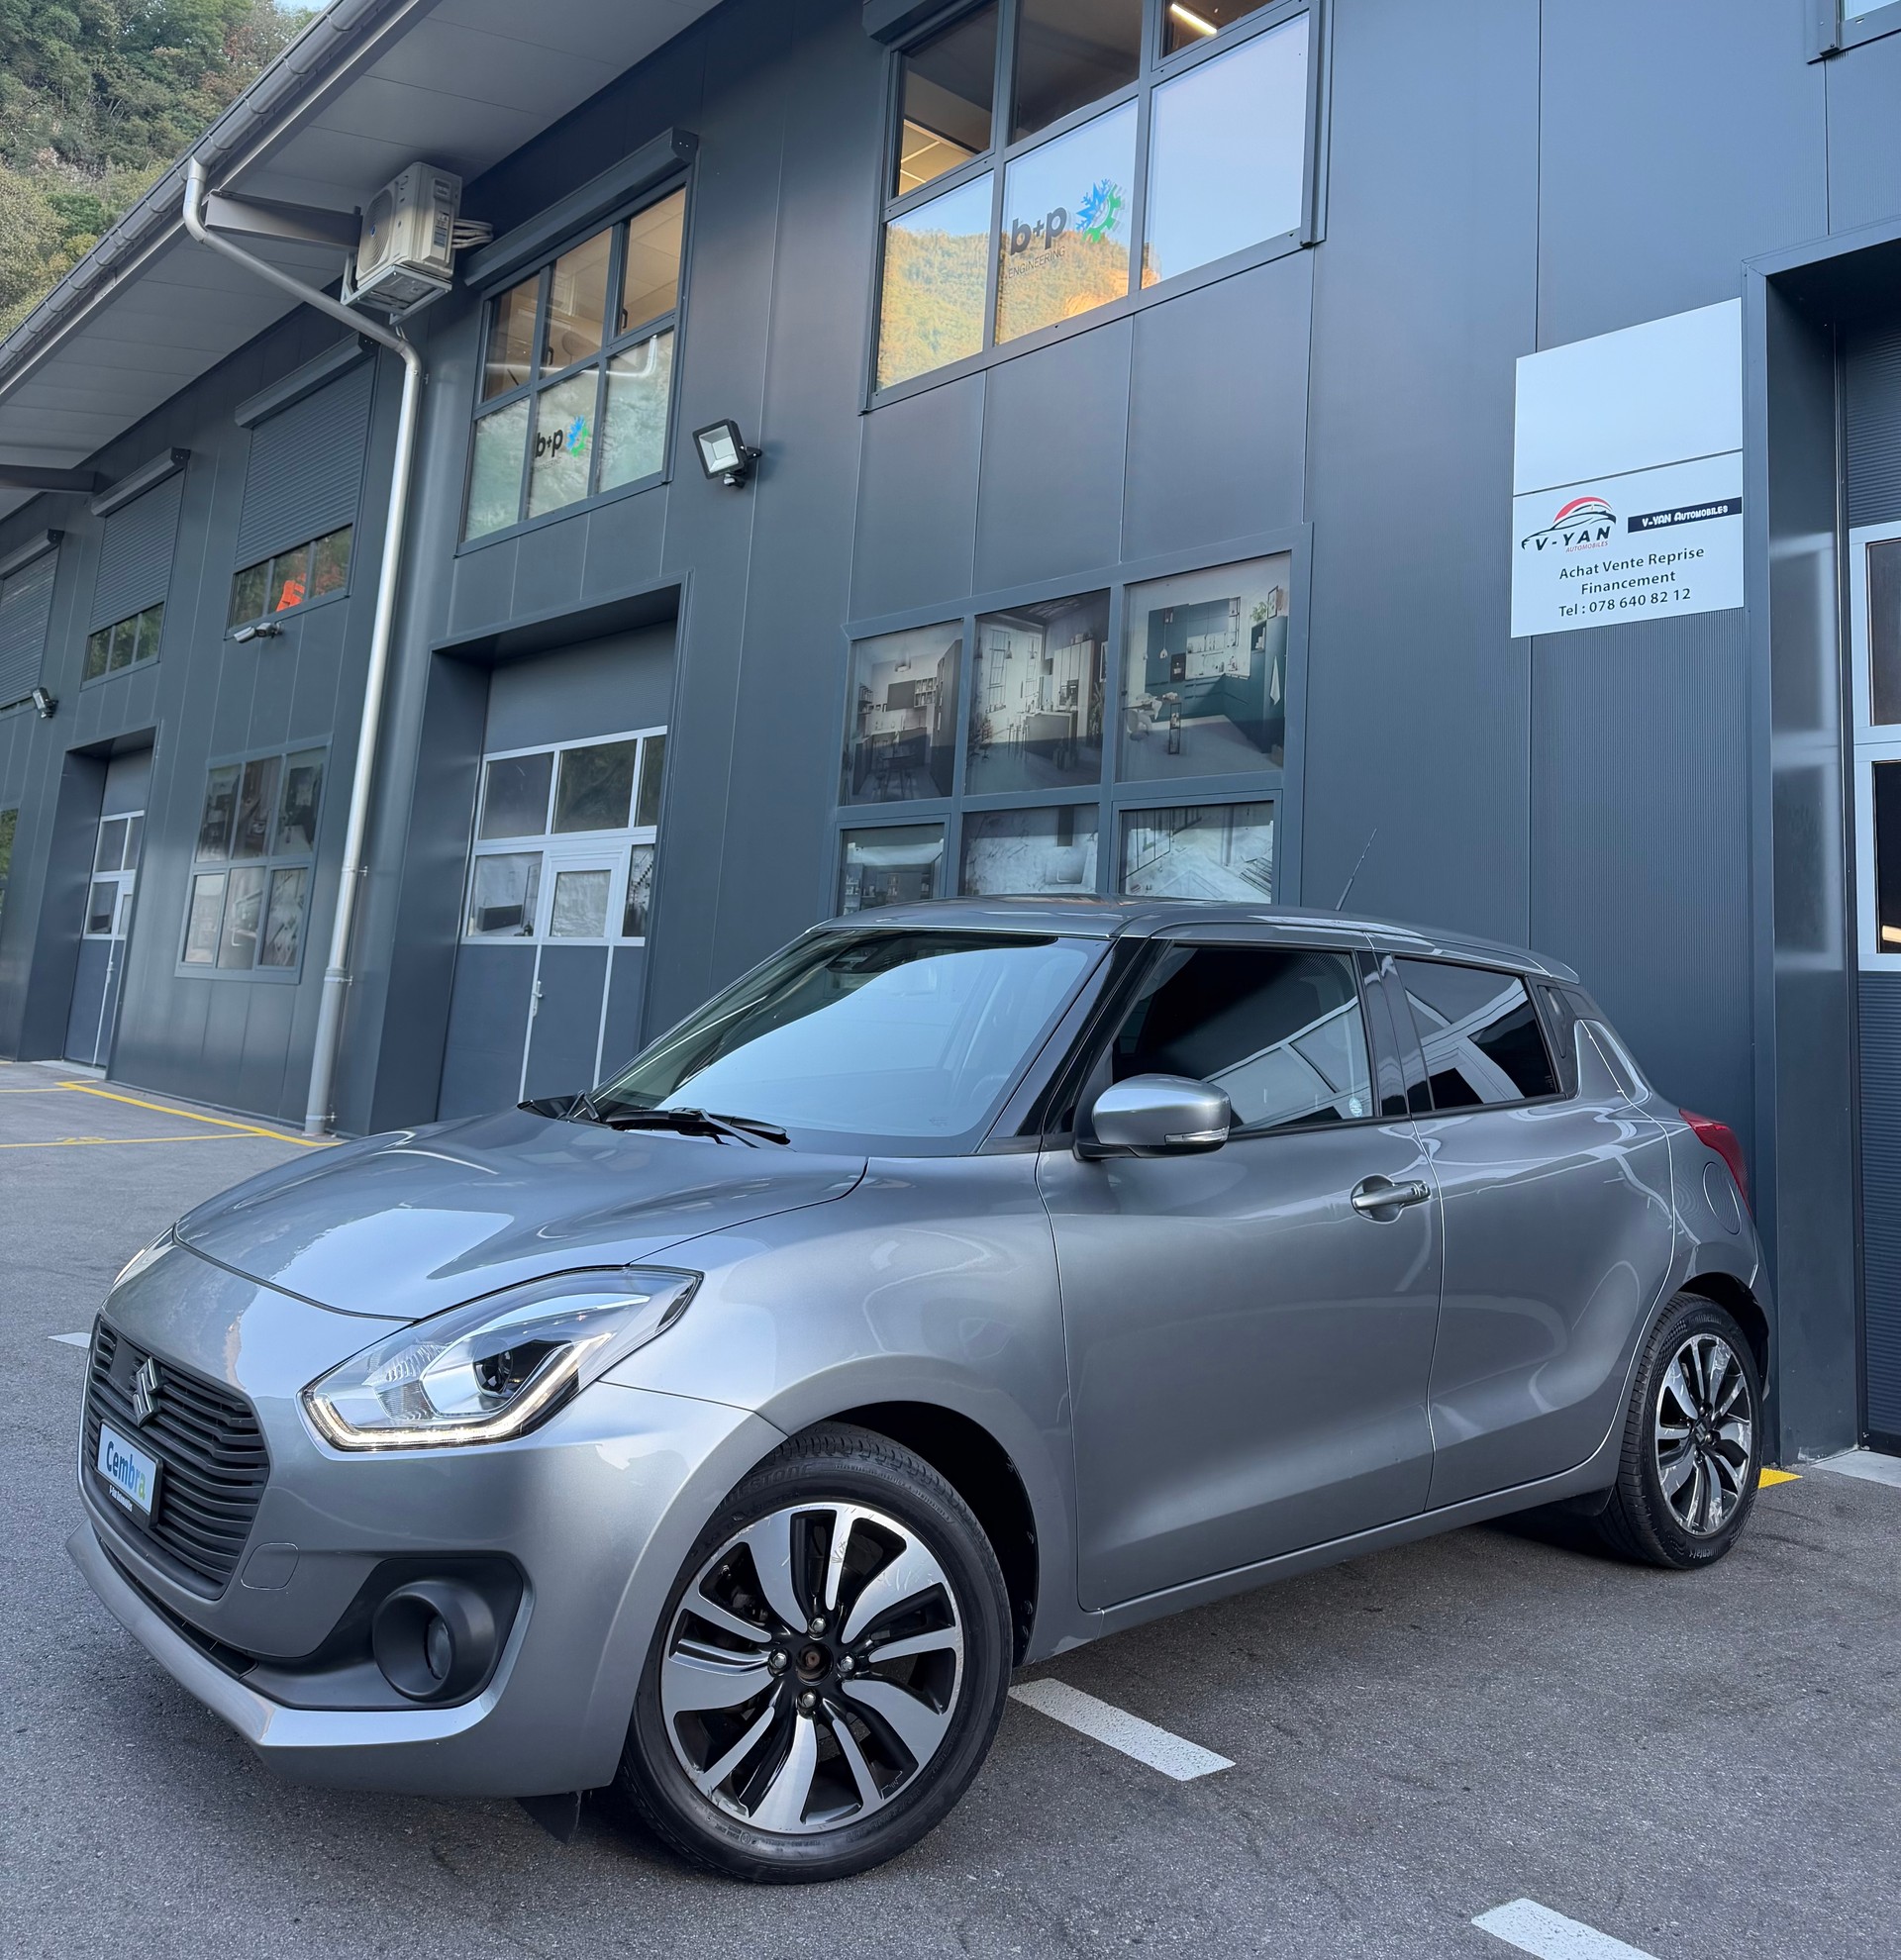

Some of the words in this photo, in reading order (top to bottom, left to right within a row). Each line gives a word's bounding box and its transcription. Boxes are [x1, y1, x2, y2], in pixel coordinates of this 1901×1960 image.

[1010, 207, 1067, 255] b+p
[1008, 245, 1065, 279] ENGINEERING
[535, 430, 563, 458] b+p
[1642, 513, 1671, 528] V-YAN
[1673, 505, 1729, 522] AUTOMOBILES
[1535, 526, 1612, 551] V-YAN
[1565, 540, 1609, 553] AUTOMOBILES
[1558, 563, 1600, 580] Achat
[1602, 556, 1645, 572] Vente
[1649, 546, 1705, 566] Reprise
[1581, 570, 1676, 595] Financement
[1589, 598, 1615, 613] 078
[1619, 594, 1647, 609] 640
[1651, 590, 1668, 604] 82
[1674, 588, 1691, 601] 12
[106, 1440, 146, 1501] Cembra
